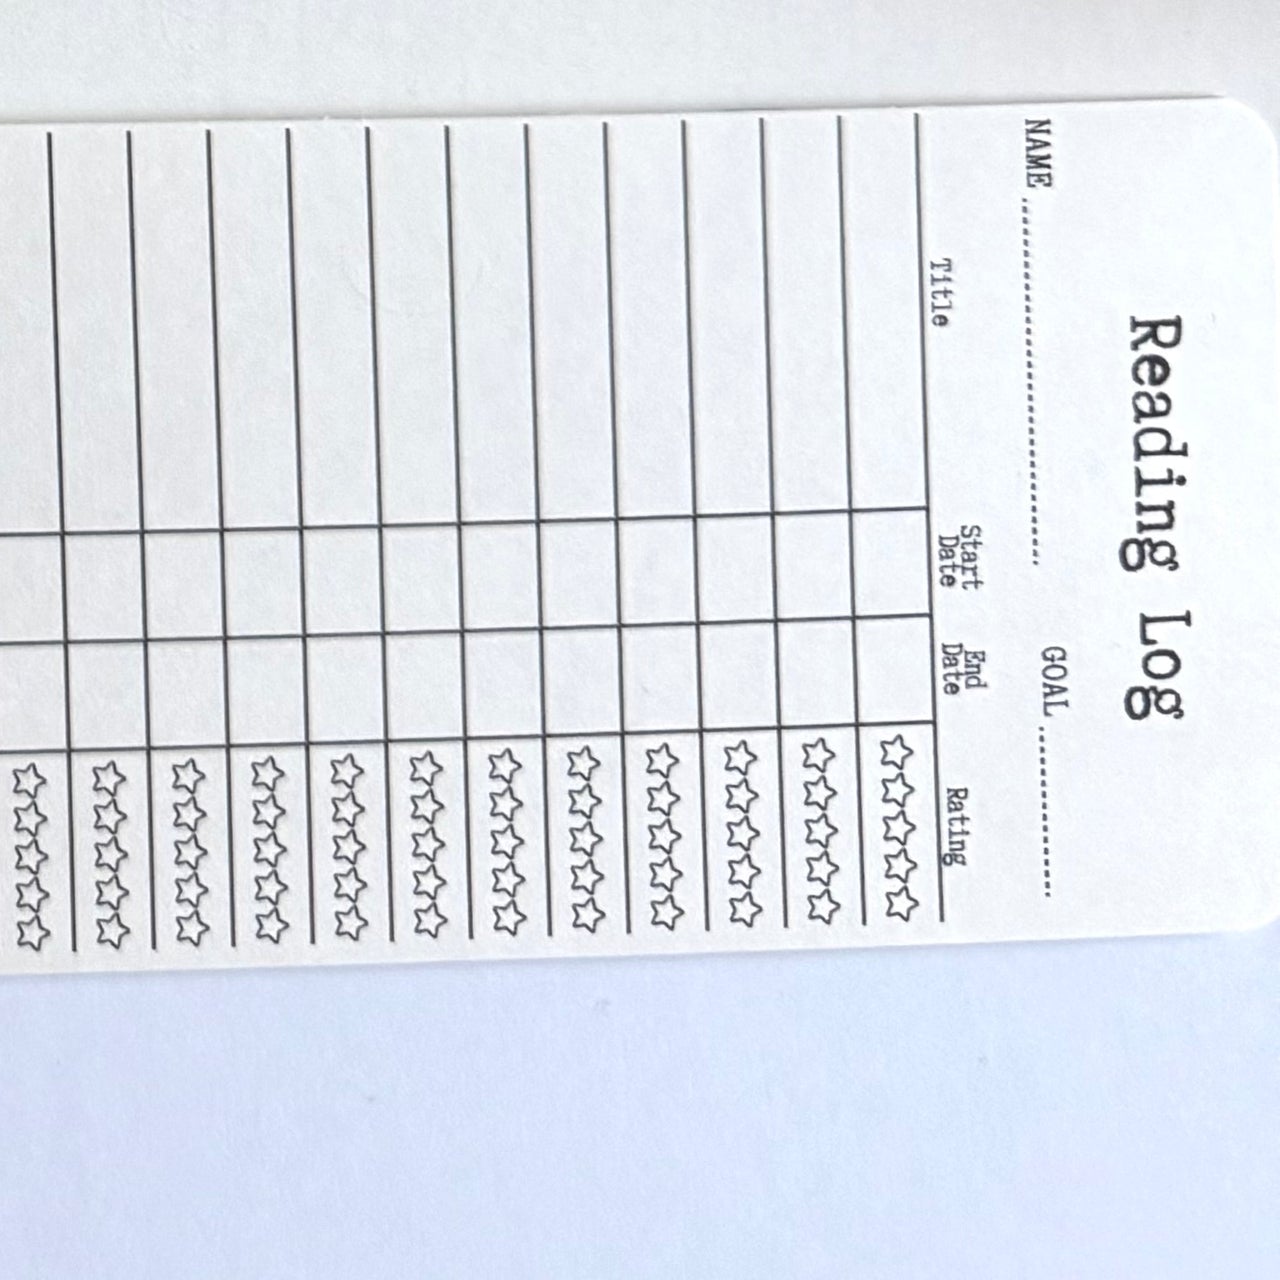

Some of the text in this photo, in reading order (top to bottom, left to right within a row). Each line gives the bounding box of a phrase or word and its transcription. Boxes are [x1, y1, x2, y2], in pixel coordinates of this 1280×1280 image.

[1024, 118, 1053, 189] NAME
[930, 257, 954, 328] Title
[1119, 315, 1192, 721] Reading Log
[939, 535, 957, 588] Date
[960, 524, 985, 591] Start
[941, 643, 961, 696] Date
[963, 650, 988, 691] End
[1040, 646, 1070, 718] GOAL
[942, 787, 969, 867] Rating
